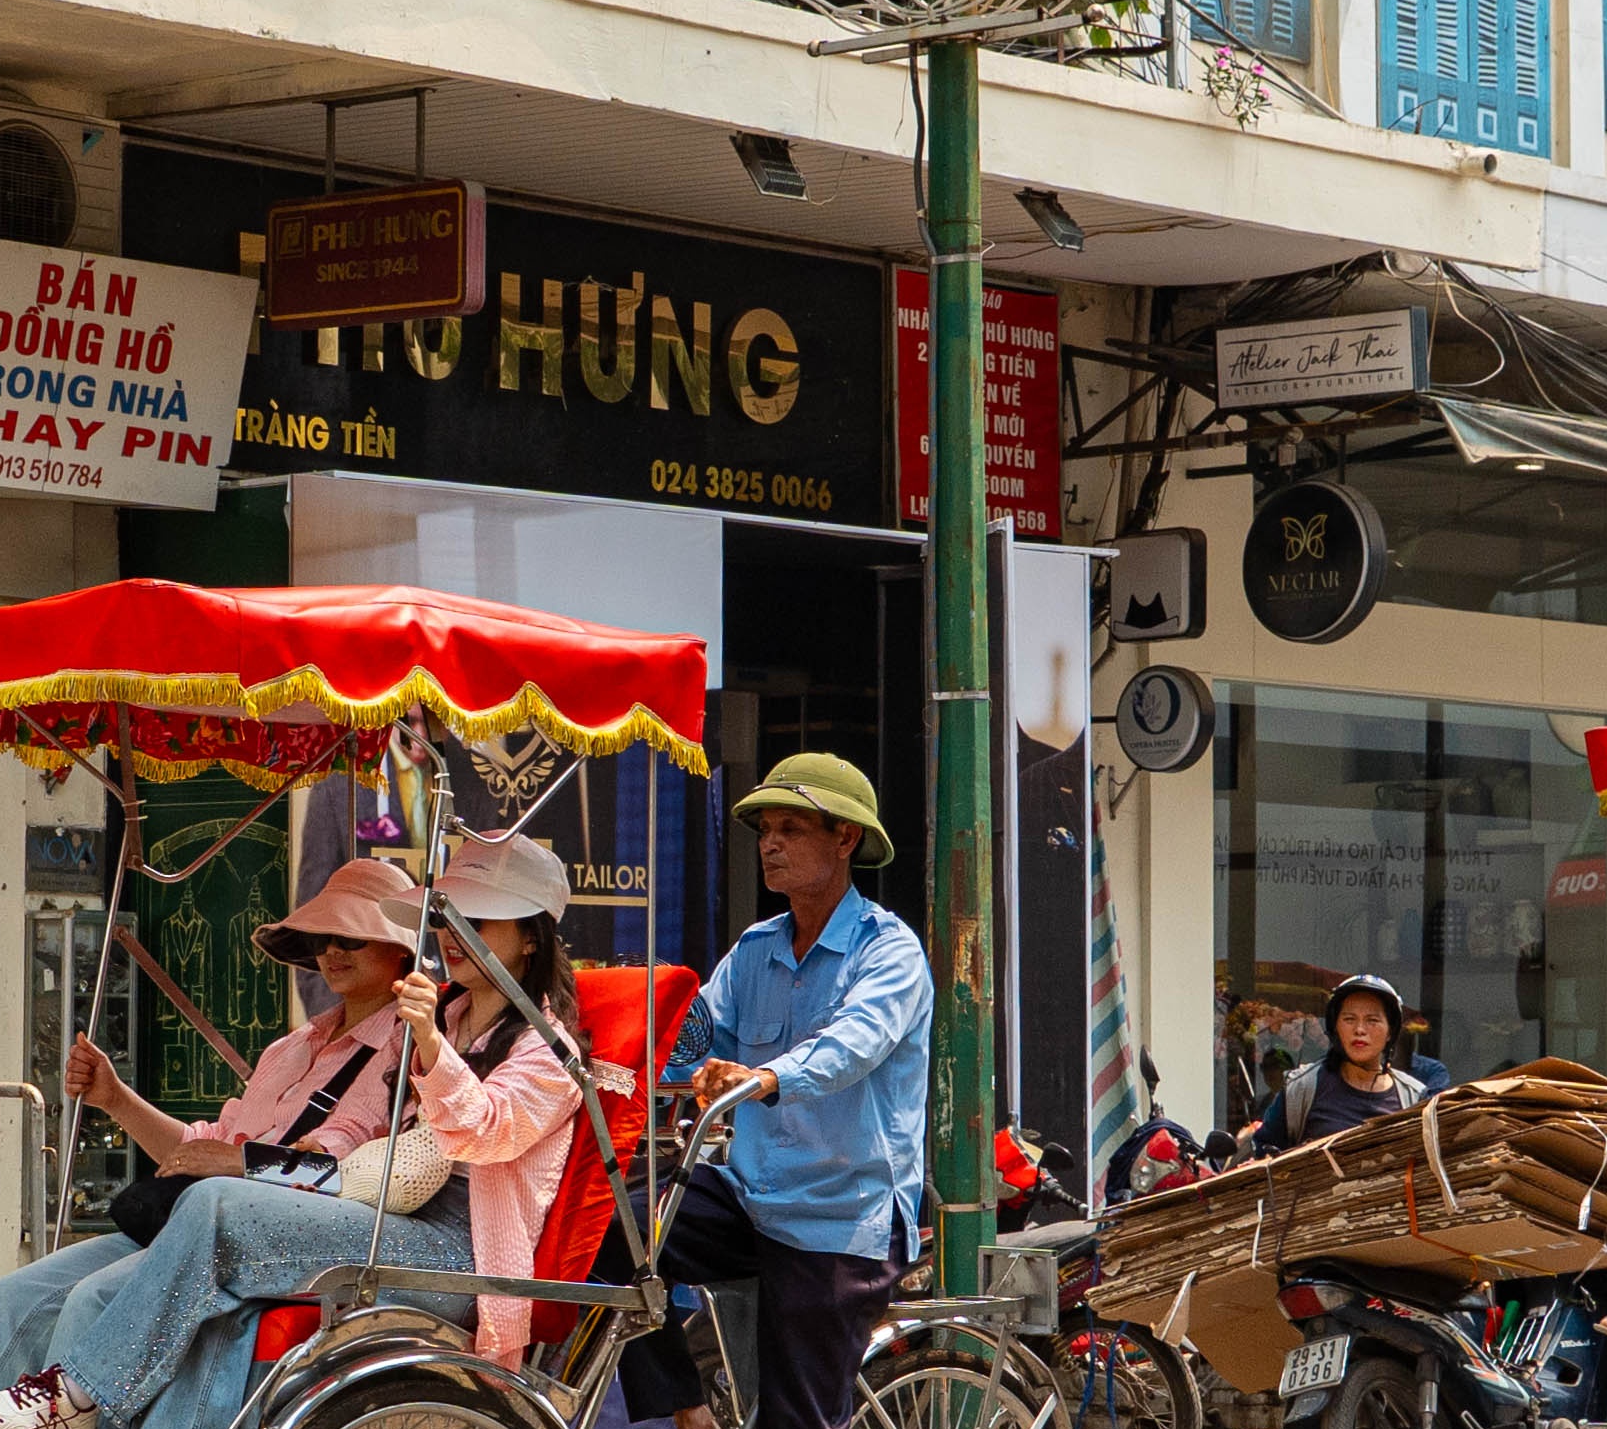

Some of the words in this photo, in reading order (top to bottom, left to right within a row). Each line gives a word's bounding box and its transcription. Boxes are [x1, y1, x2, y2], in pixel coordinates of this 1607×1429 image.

[37, 259, 137, 317] BÁN
[316, 259, 368, 283] SINCE
[374, 253, 420, 278] 1944
[115, 322, 175, 375] HỒ
[498, 271, 801, 425] HƯNG
[982, 320, 1007, 344] HÚ
[1011, 325, 1055, 351] HƯNG
[1228, 343, 1290, 379] Atelier
[1296, 338, 1344, 373] Jack
[1348, 333, 1399, 367] Thai
[107, 379, 188, 422] NHÀ
[121, 426, 212, 467] PIN
[234, 398, 330, 452] TRÀNG
[341, 406, 397, 460] TIỀN
[29, 458, 63, 484] 510
[67, 460, 103, 489] 784
[651, 458, 698, 496] 024
[705, 466, 765, 504] 3825
[771, 475, 833, 511] 0066
[1017, 509, 1047, 532] 568
[1268, 571, 1341, 592] NECTAR
[573, 863, 647, 891] TAILOR
[1288, 1361, 1333, 1389] 0296
